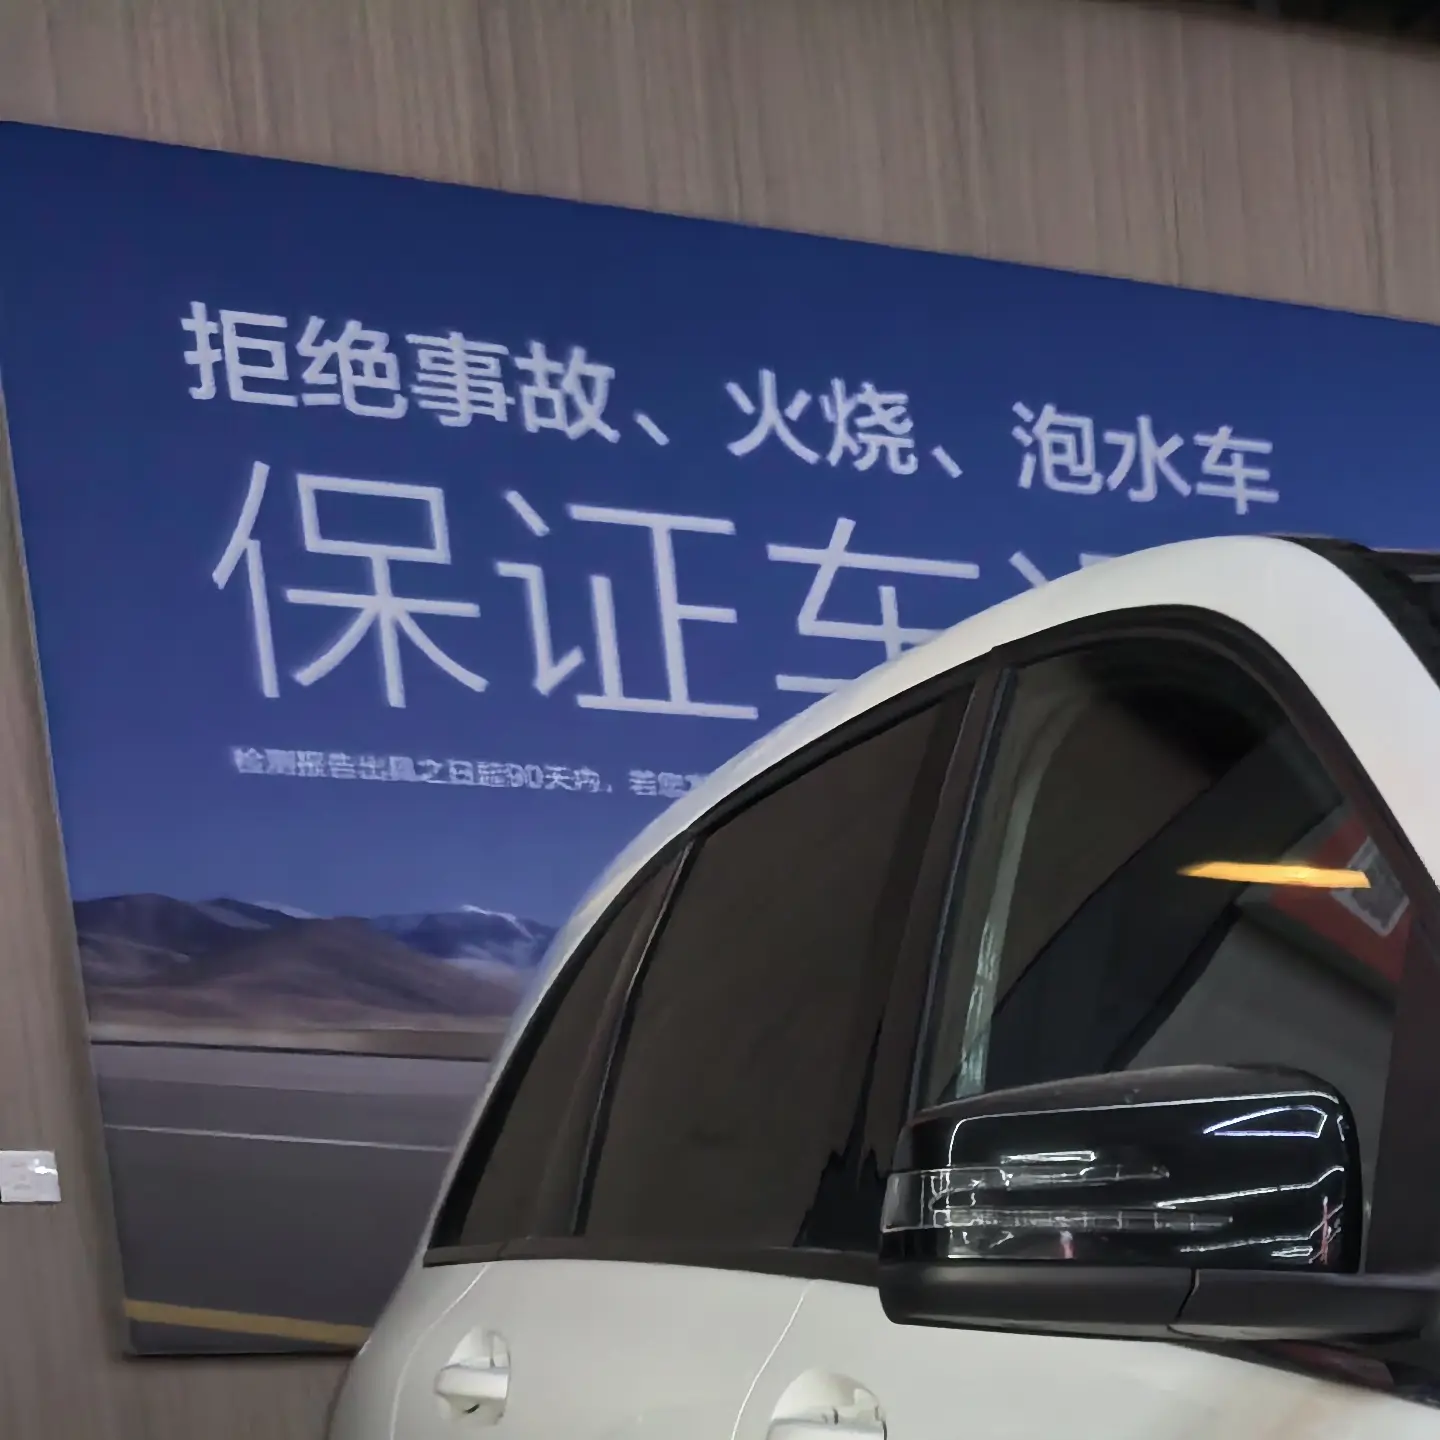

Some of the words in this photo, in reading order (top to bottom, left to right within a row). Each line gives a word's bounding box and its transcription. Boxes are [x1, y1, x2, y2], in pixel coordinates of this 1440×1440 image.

[180, 300, 1280, 516] 拒绝事故、火烧、泡水车
[211, 461, 1117, 722] 保证车
